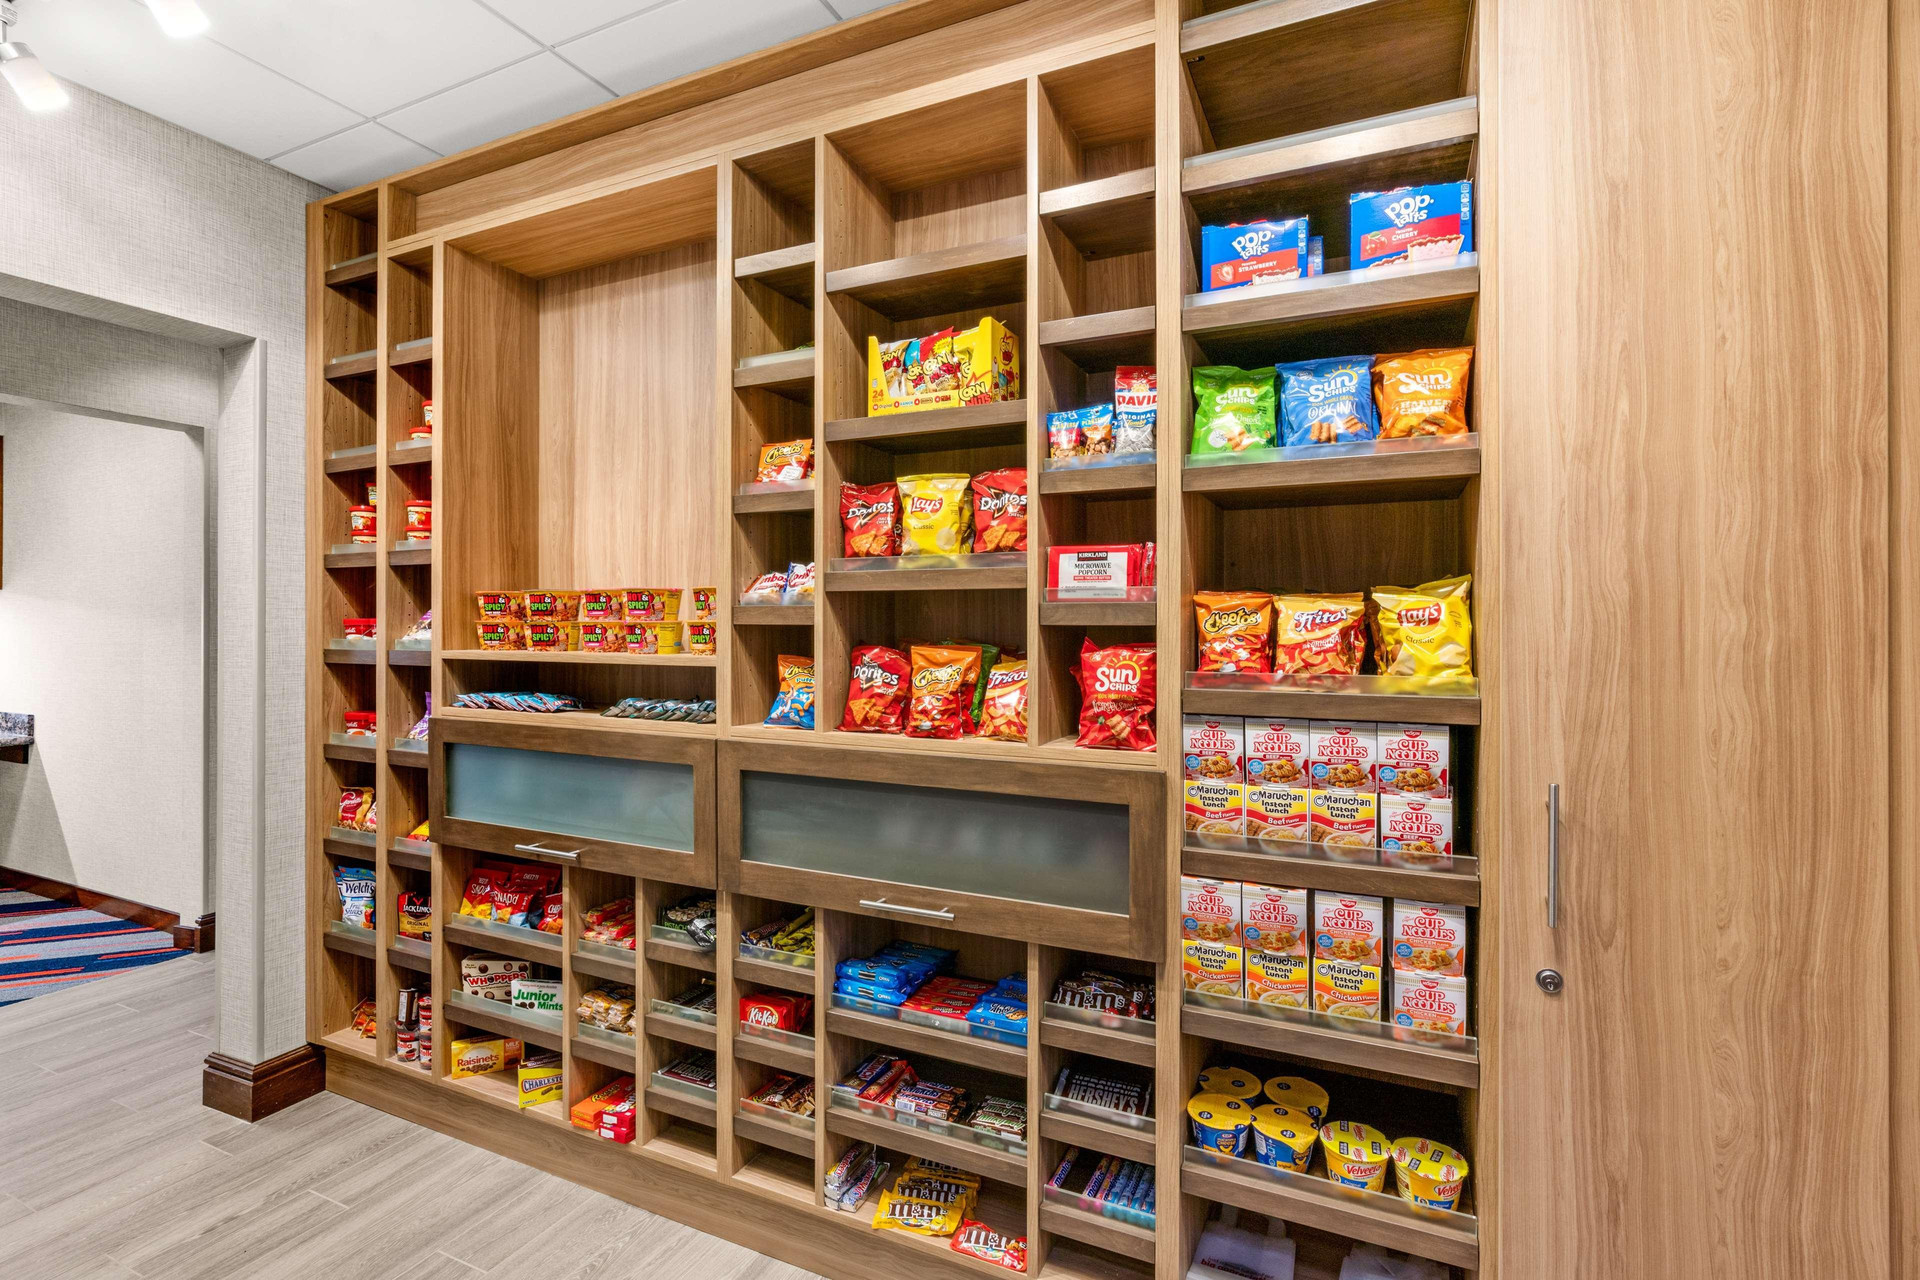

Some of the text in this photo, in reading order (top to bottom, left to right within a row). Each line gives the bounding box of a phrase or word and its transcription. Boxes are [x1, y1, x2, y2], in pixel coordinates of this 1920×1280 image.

[1392, 230, 1418, 241] CHERRY
[1238, 261, 1277, 273] STRAWBERRY
[958, 380, 986, 401] CORN
[1308, 375, 1349, 402] Sun
[1326, 385, 1356, 398] CHIPS
[1228, 397, 1256, 405] CHIPS
[1118, 412, 1156, 420] ORIGINAL
[911, 497, 942, 514] Lay's
[483, 596, 499, 604] HOT
[530, 595, 545, 603] HOT
[585, 594, 600, 603] HOT
[627, 592, 642, 601] HOT
[484, 603, 506, 611] SPICY
[531, 603, 551, 611] SPICY
[586, 602, 606, 610] SPICY
[628, 601, 648, 610] SPICY
[1400, 605, 1439, 627] Lay's
[482, 625, 498, 633] HOT
[531, 625, 547, 634] HOT
[582, 625, 596, 634] HOT
[690, 626, 703, 635] HOT
[532, 633, 553, 642] SPICY
[584, 634, 602, 642] SPICY
[691, 635, 709, 643] SPICY
[1406, 635, 1435, 644] Classic
[853, 665, 899, 686] Doritos
[1095, 666, 1139, 692] Sun
[1109, 682, 1137, 693] CHIPS
[1201, 730, 1226, 740] CUP
[1264, 732, 1291, 743] CUP
[1190, 738, 1235, 750] NOODLES
[1329, 736, 1358, 747] CUP
[1398, 739, 1429, 751] CUP
[1253, 742, 1301, 754] NOODLES
[1318, 745, 1369, 758] NOODLES
[1385, 748, 1439, 762] NOODLES
[1196, 785, 1239, 796] Maruchan
[1258, 790, 1304, 802] Maruchan
[1200, 794, 1229, 803] Instant
[1323, 795, 1371, 807] Maruchan
[1202, 801, 1226, 809] Lunch
[1262, 800, 1292, 809] Instant
[1327, 804, 1359, 814] Instant
[1268, 817, 1286, 825] Beef
[1330, 812, 1356, 820] Lunch
[1402, 812, 1432, 824] CUP
[1333, 822, 1352, 831] Beef
[1389, 820, 1443, 836] NOODLES
[344, 882, 375, 894] Welch's
[1198, 894, 1223, 905] CUP
[403, 904, 417, 913] JACK
[1188, 901, 1233, 917] NOODLES
[1260, 902, 1288, 913] CUP
[1250, 909, 1297, 925] NOODLES
[1334, 908, 1363, 920] CUP
[1323, 916, 1373, 932] NOODLES
[1414, 916, 1445, 929] CUP
[1402, 924, 1456, 941] NOODLES
[1409, 938, 1437, 946] CHICKEN
[1194, 945, 1237, 960] Maruchan
[1198, 955, 1227, 965] Instant
[1201, 961, 1224, 970] Lunch
[1258, 954, 1304, 968] Maruchan
[1262, 964, 1293, 974] Instant
[1327, 964, 1375, 980] Maruchan
[468, 972, 527, 986] WHOPPERS
[1197, 970, 1226, 980] Chicken
[1265, 970, 1290, 980] Lunch
[1331, 974, 1364, 986] Instant
[1262, 979, 1292, 989] Chicken
[1334, 981, 1360, 991] Lunch
[513, 988, 557, 1002] Junior
[1330, 990, 1362, 1002] Chicken
[1414, 988, 1445, 1001] CUP
[537, 1001, 563, 1011] Mints
[1402, 996, 1456, 1015] NOODLES
[1409, 1009, 1437, 1018] CHICKEN
[457, 1053, 500, 1067] Raisinets
